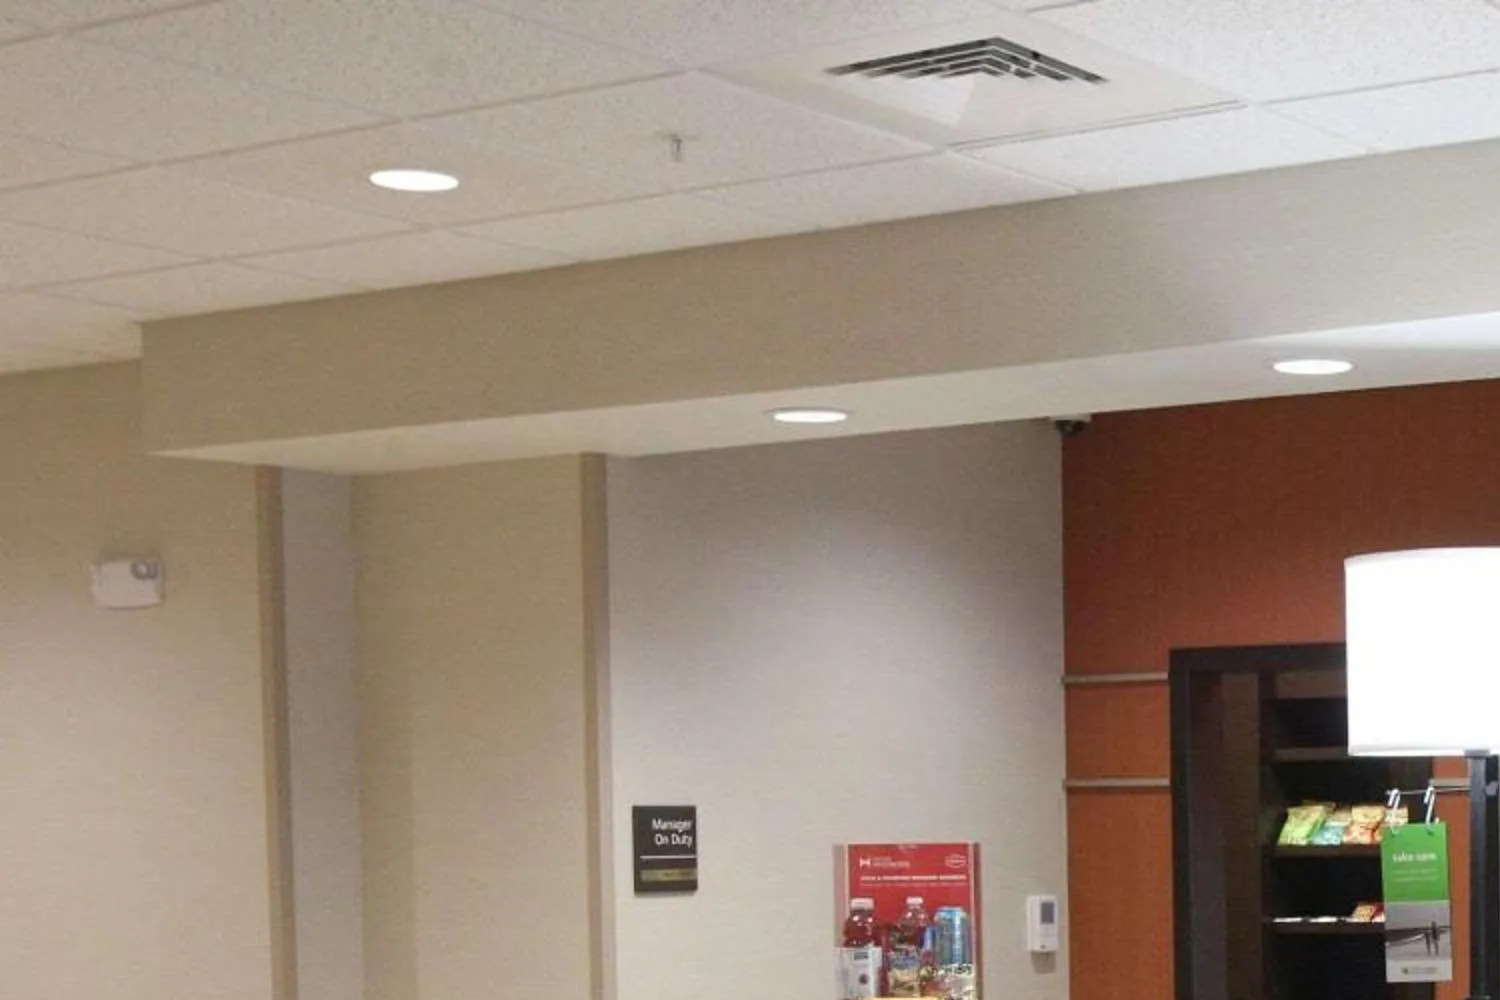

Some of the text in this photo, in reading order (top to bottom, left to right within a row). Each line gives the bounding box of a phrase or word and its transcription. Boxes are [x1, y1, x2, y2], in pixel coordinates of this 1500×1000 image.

[652, 818, 692, 833] Manager
[654, 833, 693, 848] On Duty
